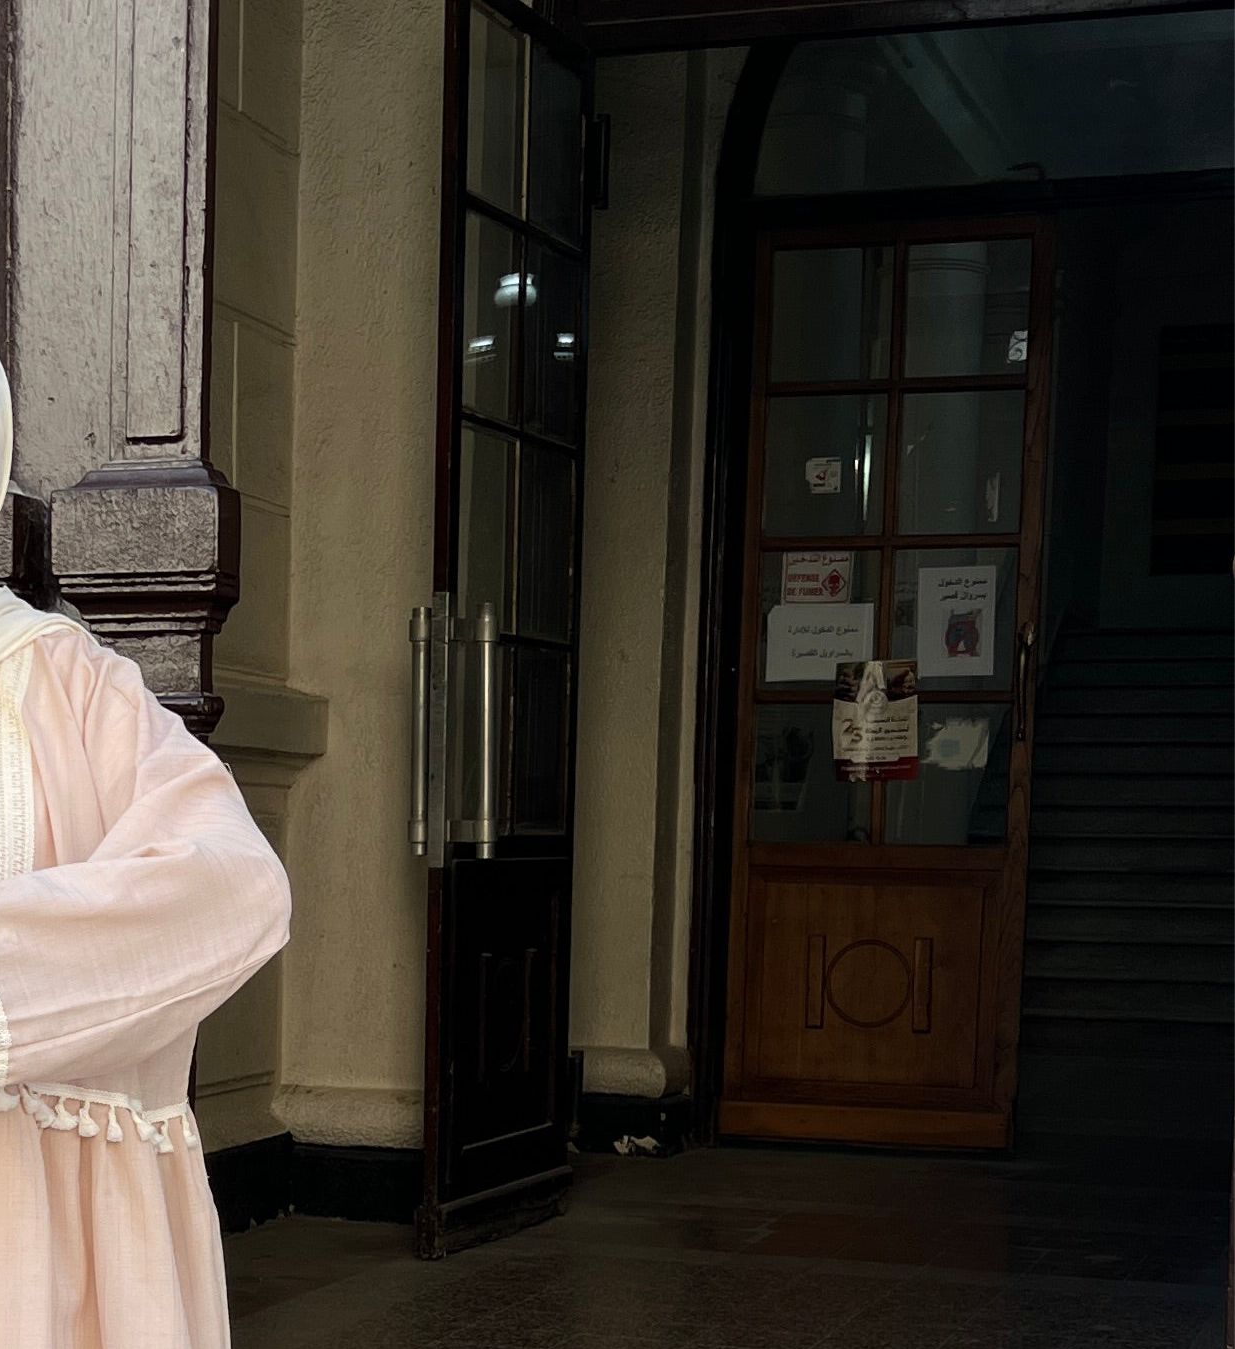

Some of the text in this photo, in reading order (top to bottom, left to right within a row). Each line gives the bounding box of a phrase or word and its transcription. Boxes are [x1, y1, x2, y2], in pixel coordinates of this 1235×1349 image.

[788, 554, 849, 566] ممنوع التدخين
[938, 577, 988, 588] ممنوع الدخول
[836, 624, 859, 636] ممنوع
